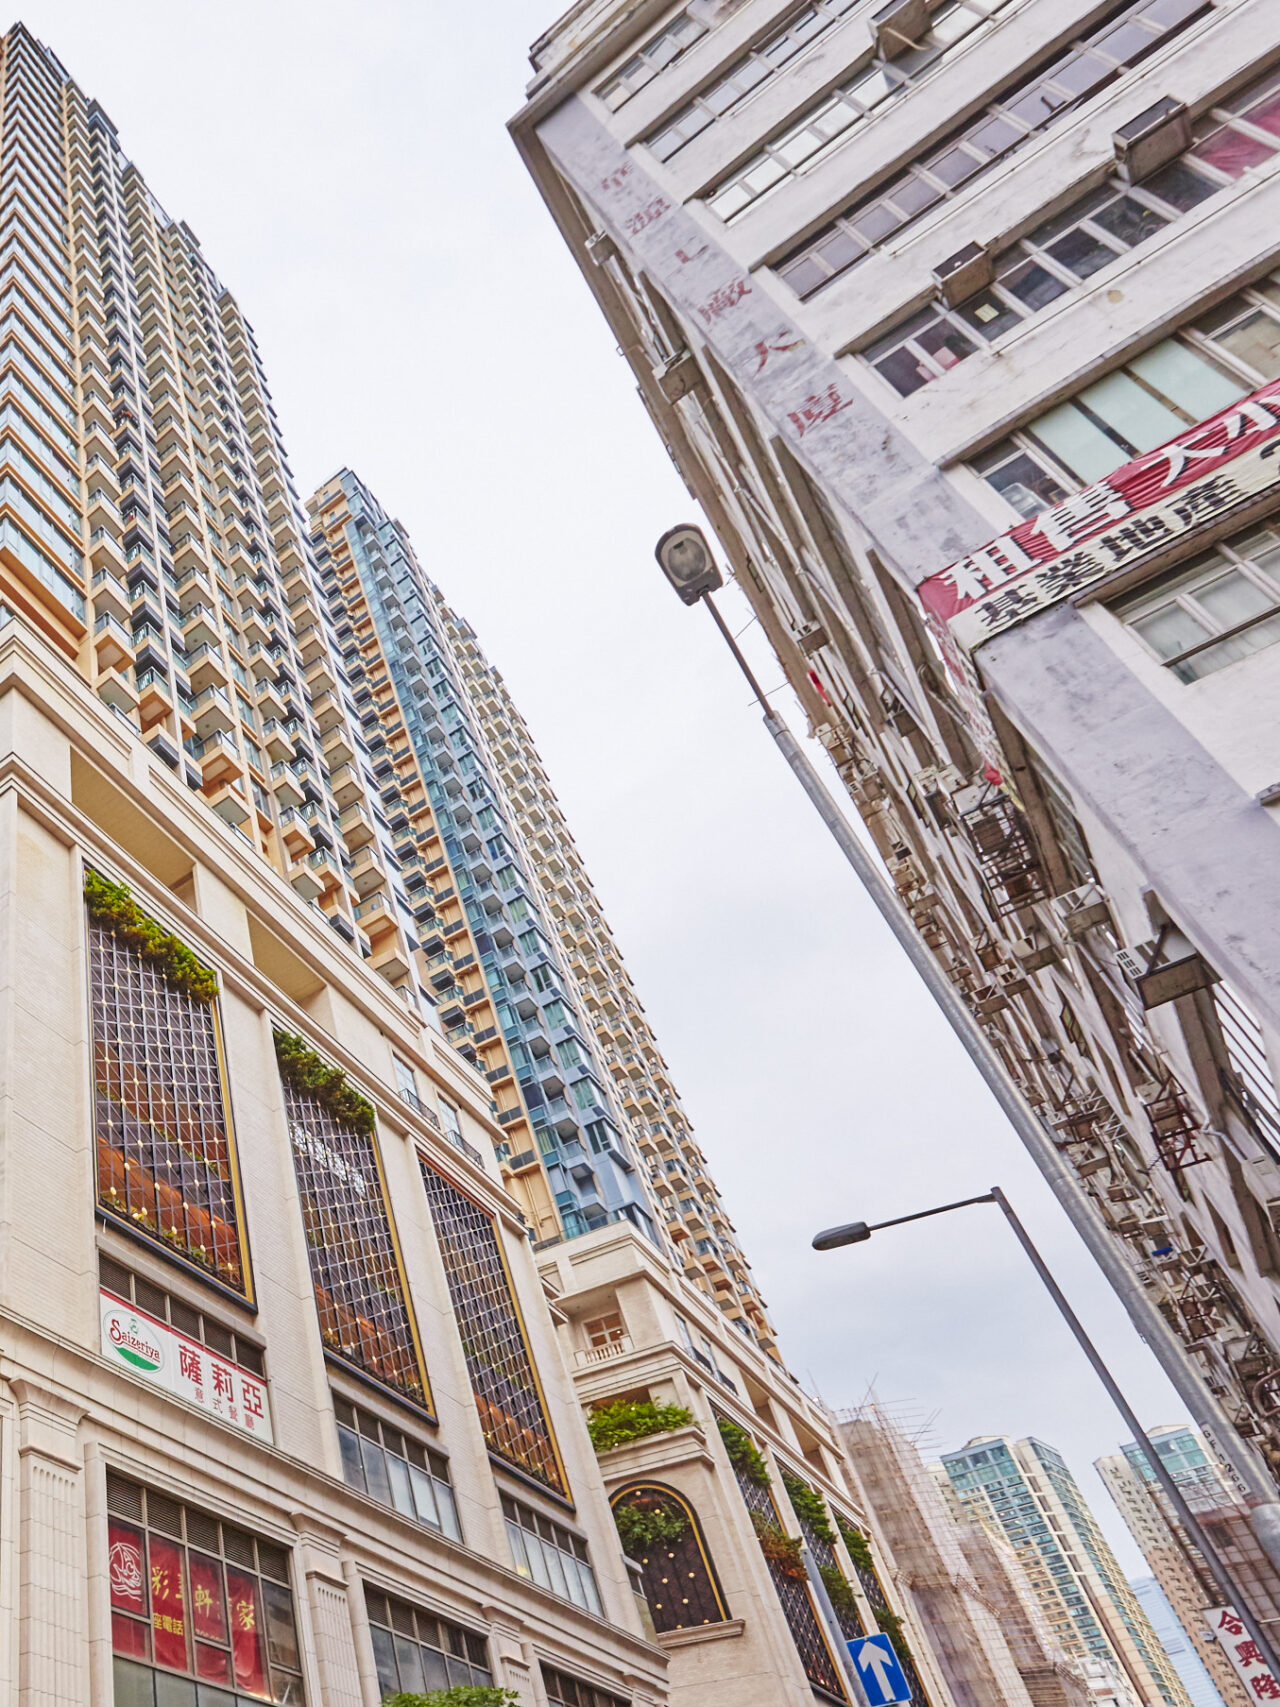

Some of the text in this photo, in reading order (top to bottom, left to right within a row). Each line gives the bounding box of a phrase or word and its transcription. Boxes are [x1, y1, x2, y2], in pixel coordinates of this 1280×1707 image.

[975, 474, 1252, 632] 基業地產
[109, 1319, 160, 1361] Saizeriya
[178, 1344, 264, 1418] 薩莉亞
